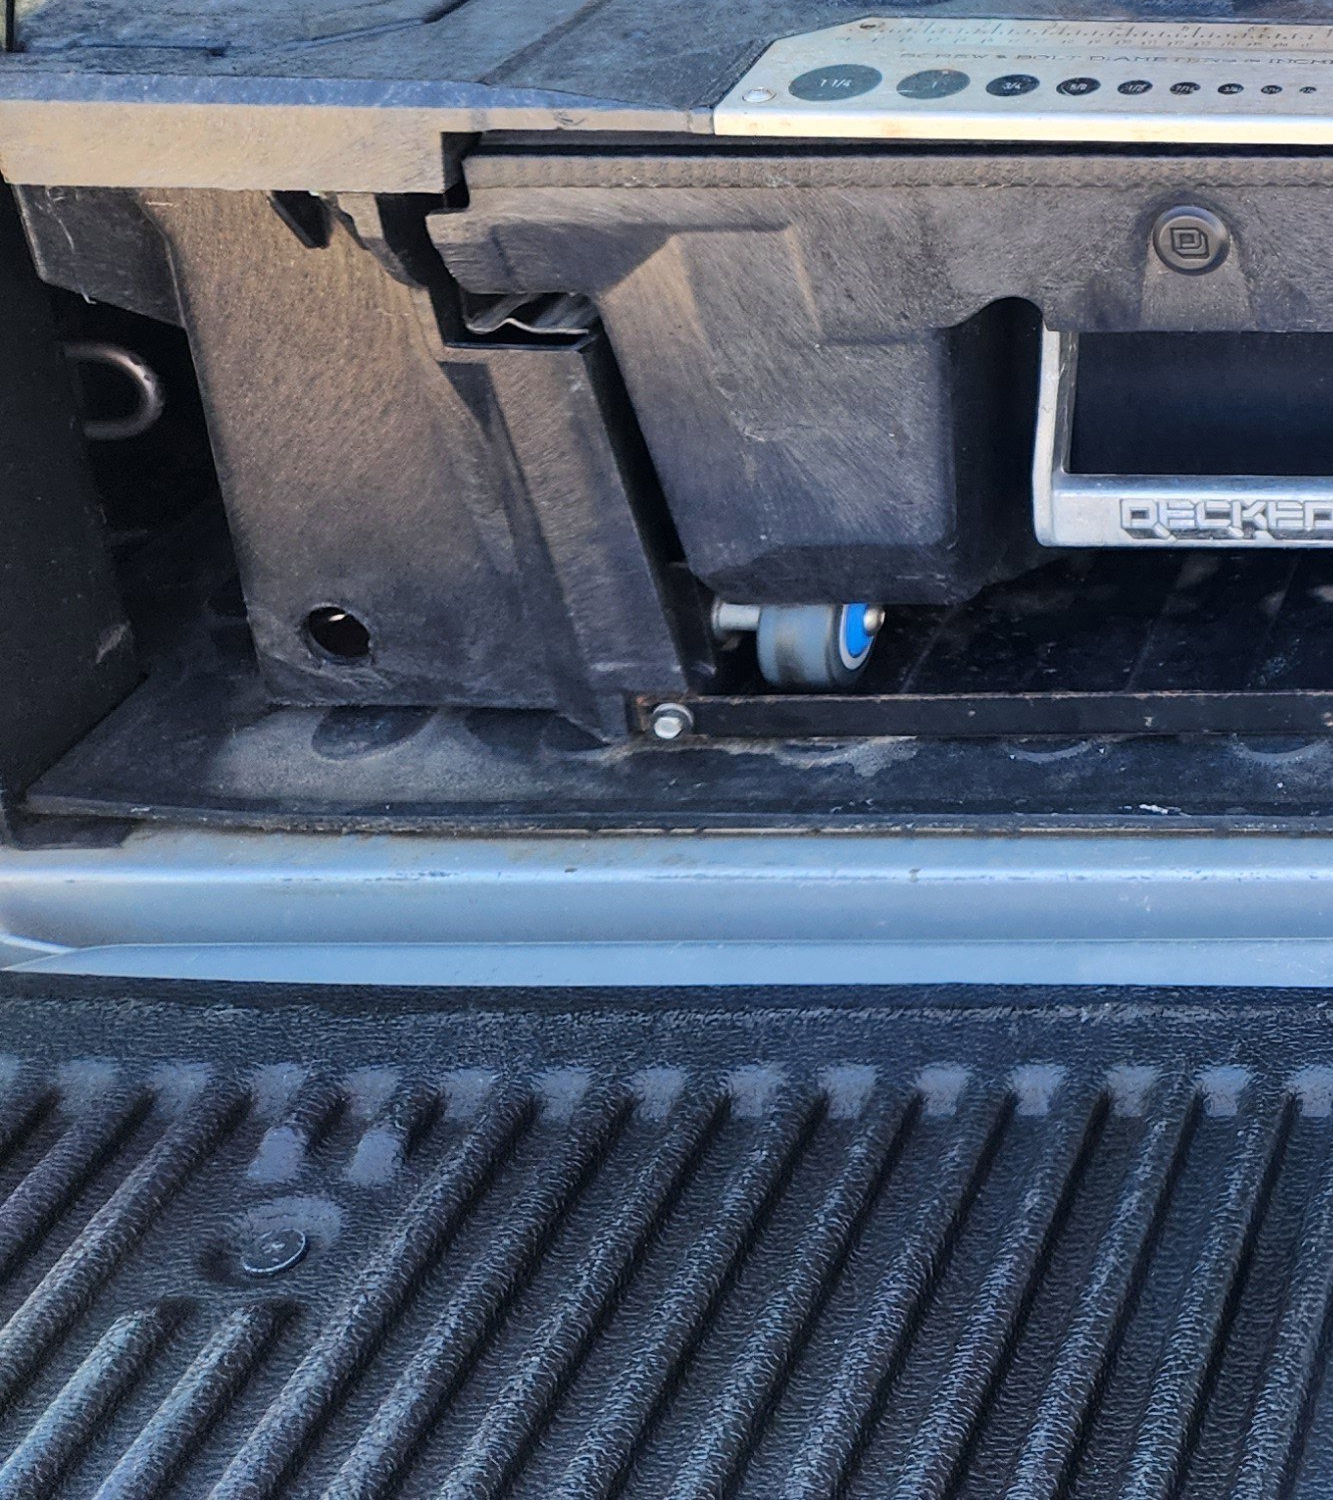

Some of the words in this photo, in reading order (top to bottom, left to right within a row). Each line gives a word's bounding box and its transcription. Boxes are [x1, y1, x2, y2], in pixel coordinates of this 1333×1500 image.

[899, 52, 990, 60] SCREW
[1015, 53, 1083, 62] BOLT
[1002, 80, 1022, 91] 3/4
